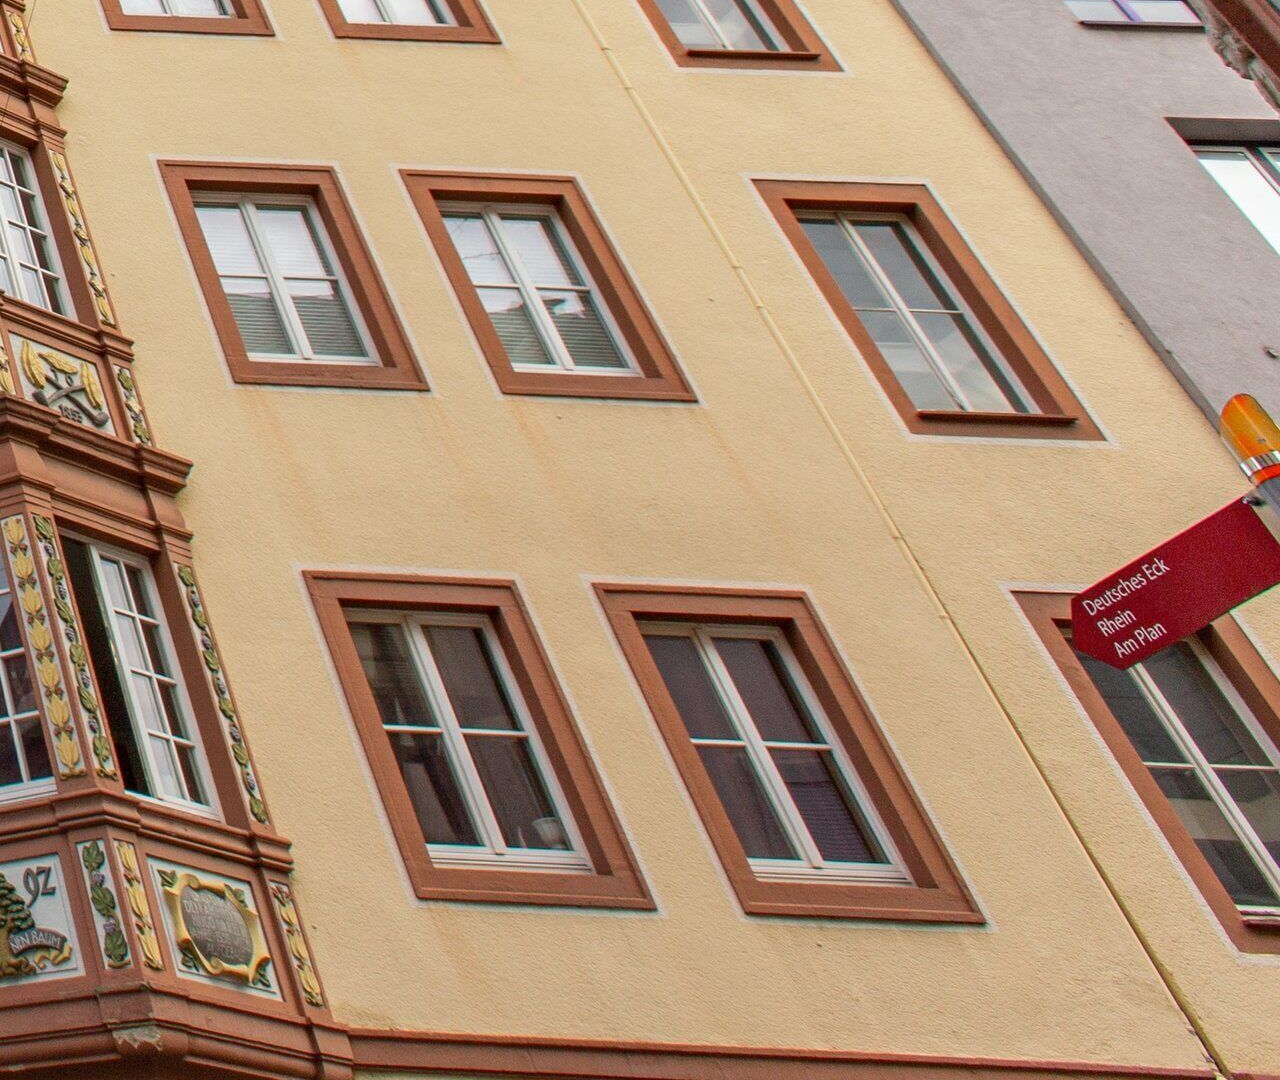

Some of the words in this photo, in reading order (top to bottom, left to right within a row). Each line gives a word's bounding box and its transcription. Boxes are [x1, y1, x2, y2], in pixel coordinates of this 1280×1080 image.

[1082, 572, 1147, 616] Deutsches
[1143, 557, 1170, 580] Eck
[1097, 608, 1137, 637] Rhein
[1114, 639, 1139, 658] Am
[1135, 621, 1167, 646] Plan
